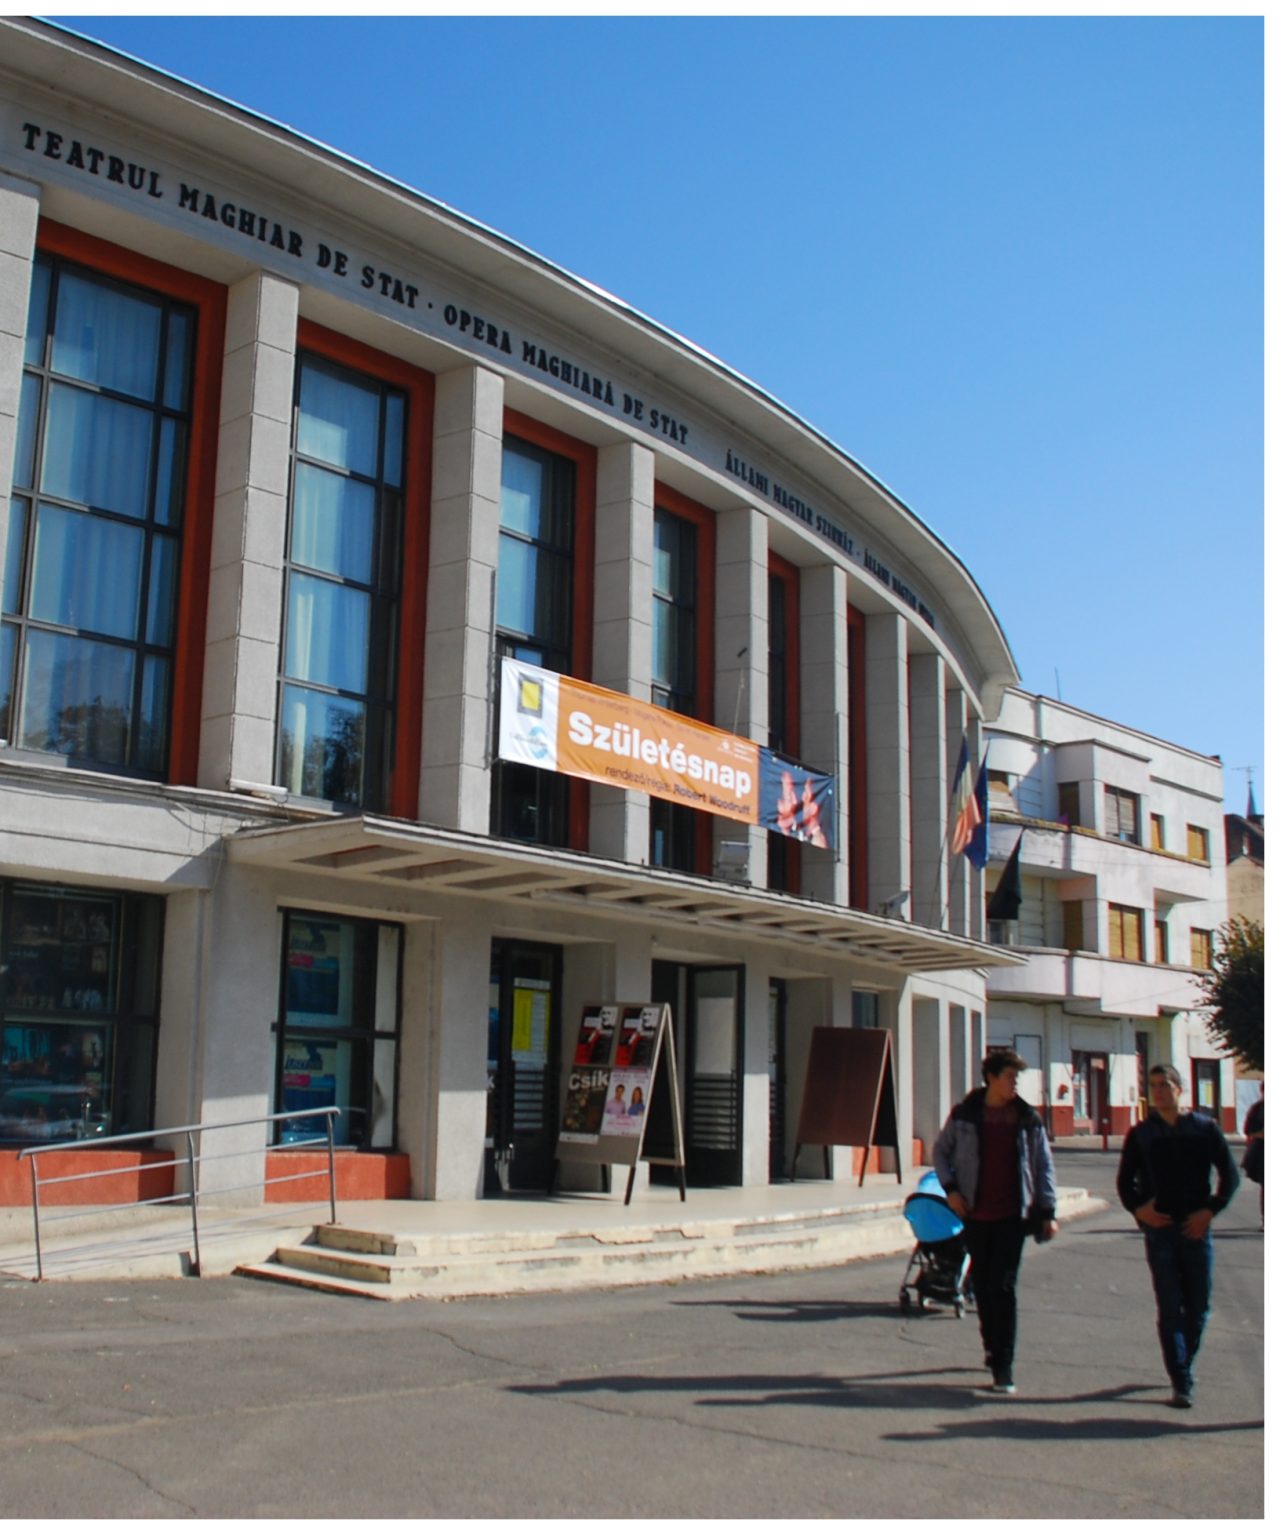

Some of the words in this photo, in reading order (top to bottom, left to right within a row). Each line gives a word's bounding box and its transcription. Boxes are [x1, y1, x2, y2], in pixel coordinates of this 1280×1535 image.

[23, 122, 163, 198] TEATRUL
[179, 183, 303, 257] MAGHIAR
[317, 243, 348, 277] DE
[361, 265, 419, 309] STAT
[444, 304, 512, 354] OPERA
[623, 393, 644, 421] DE
[650, 409, 688, 445] STAT
[773, 484, 814, 526] MAGYAR
[568, 711, 752, 798] Születésnap
[673, 784, 707, 803] Robert
